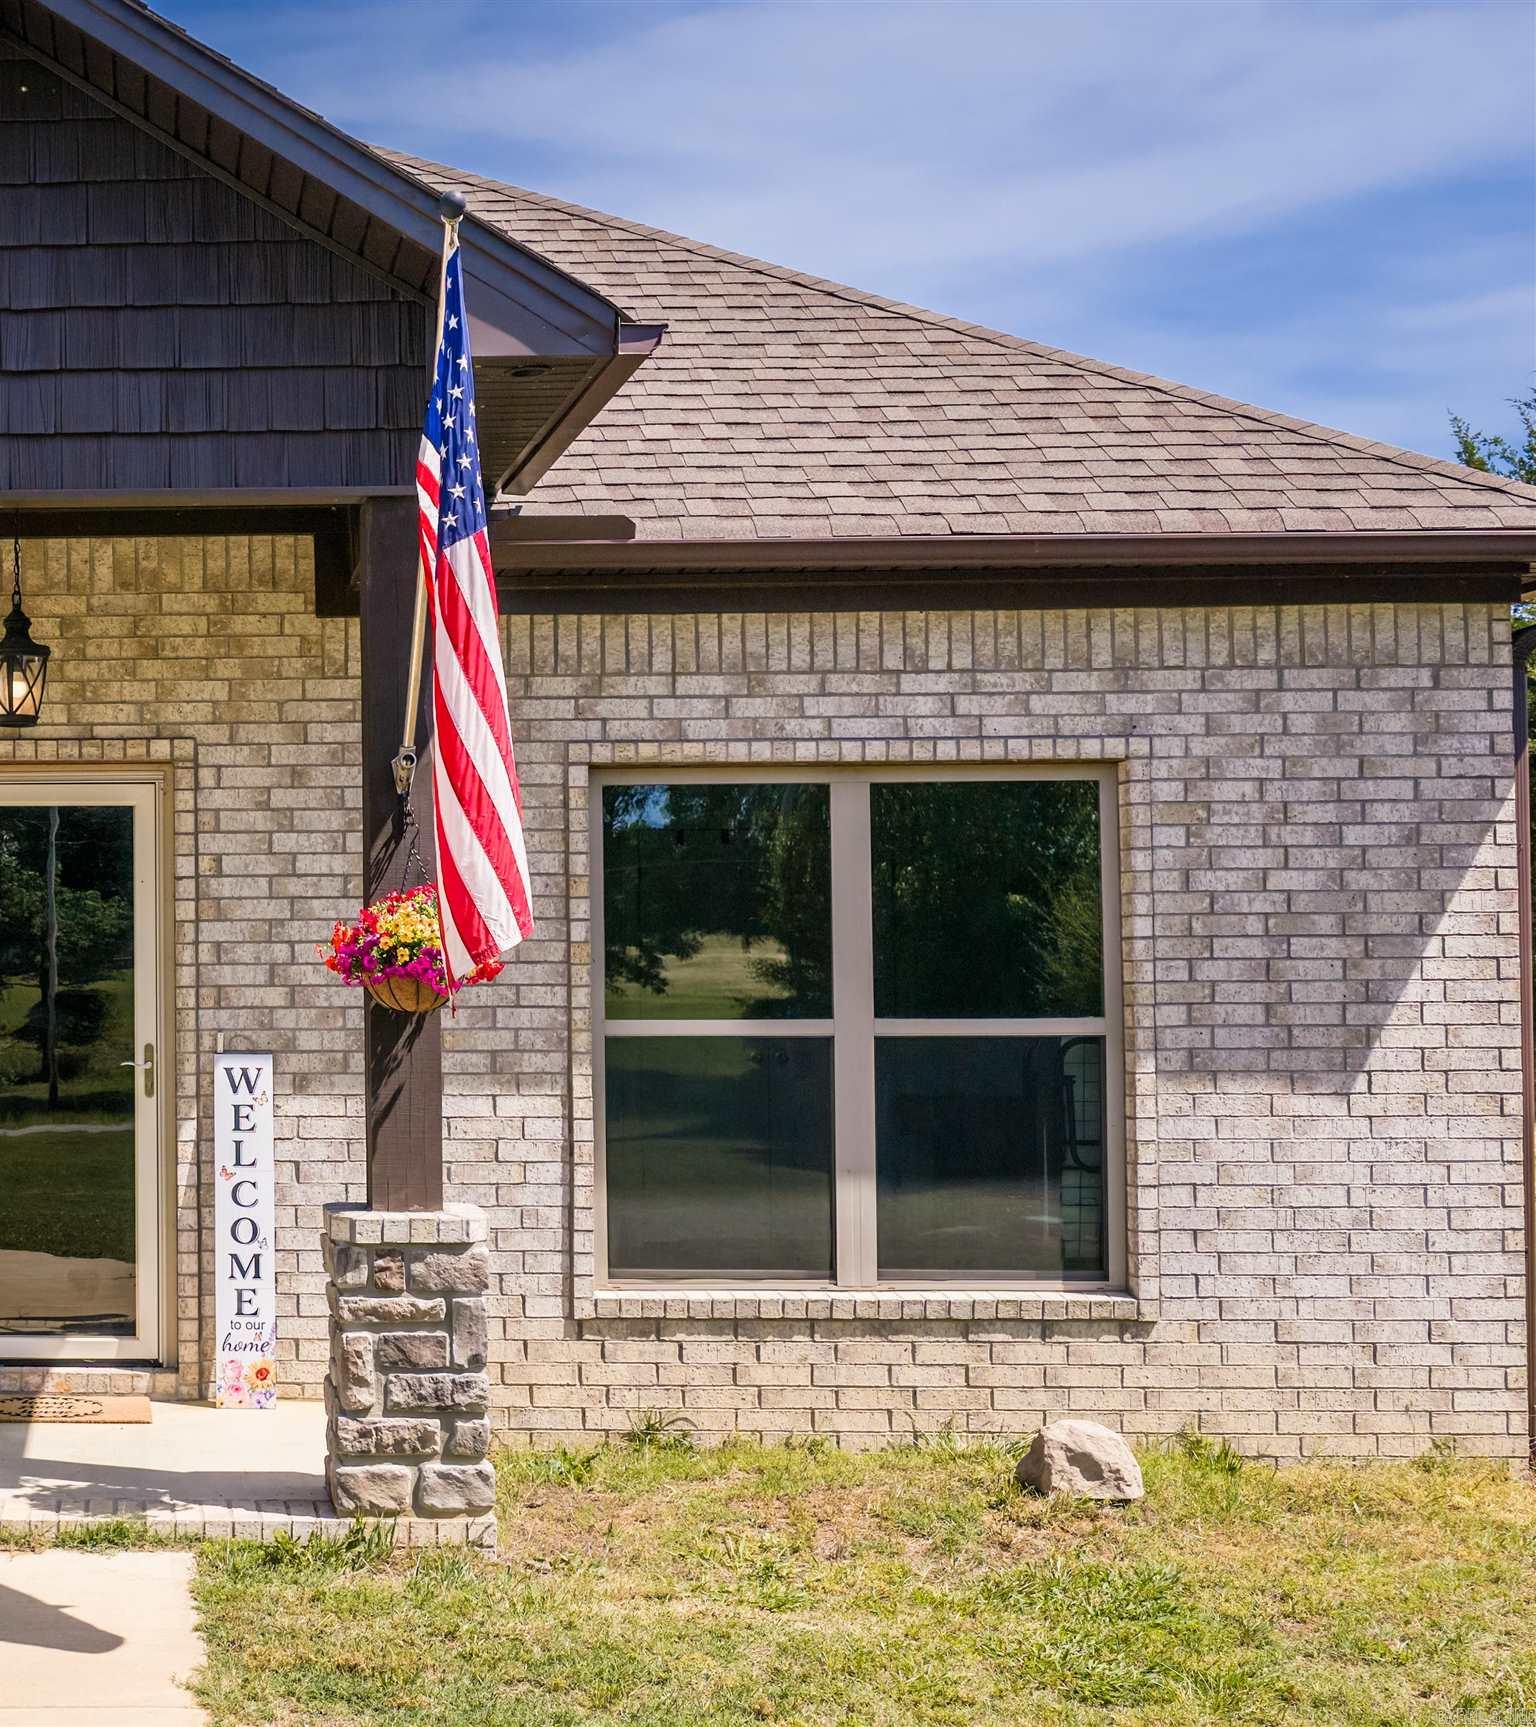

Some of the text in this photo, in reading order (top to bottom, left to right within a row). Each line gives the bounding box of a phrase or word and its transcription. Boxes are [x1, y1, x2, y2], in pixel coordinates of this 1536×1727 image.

[224, 1067, 262, 1317] WELCOME
[230, 1320, 265, 1330] to our
[222, 1332, 270, 1352] home
